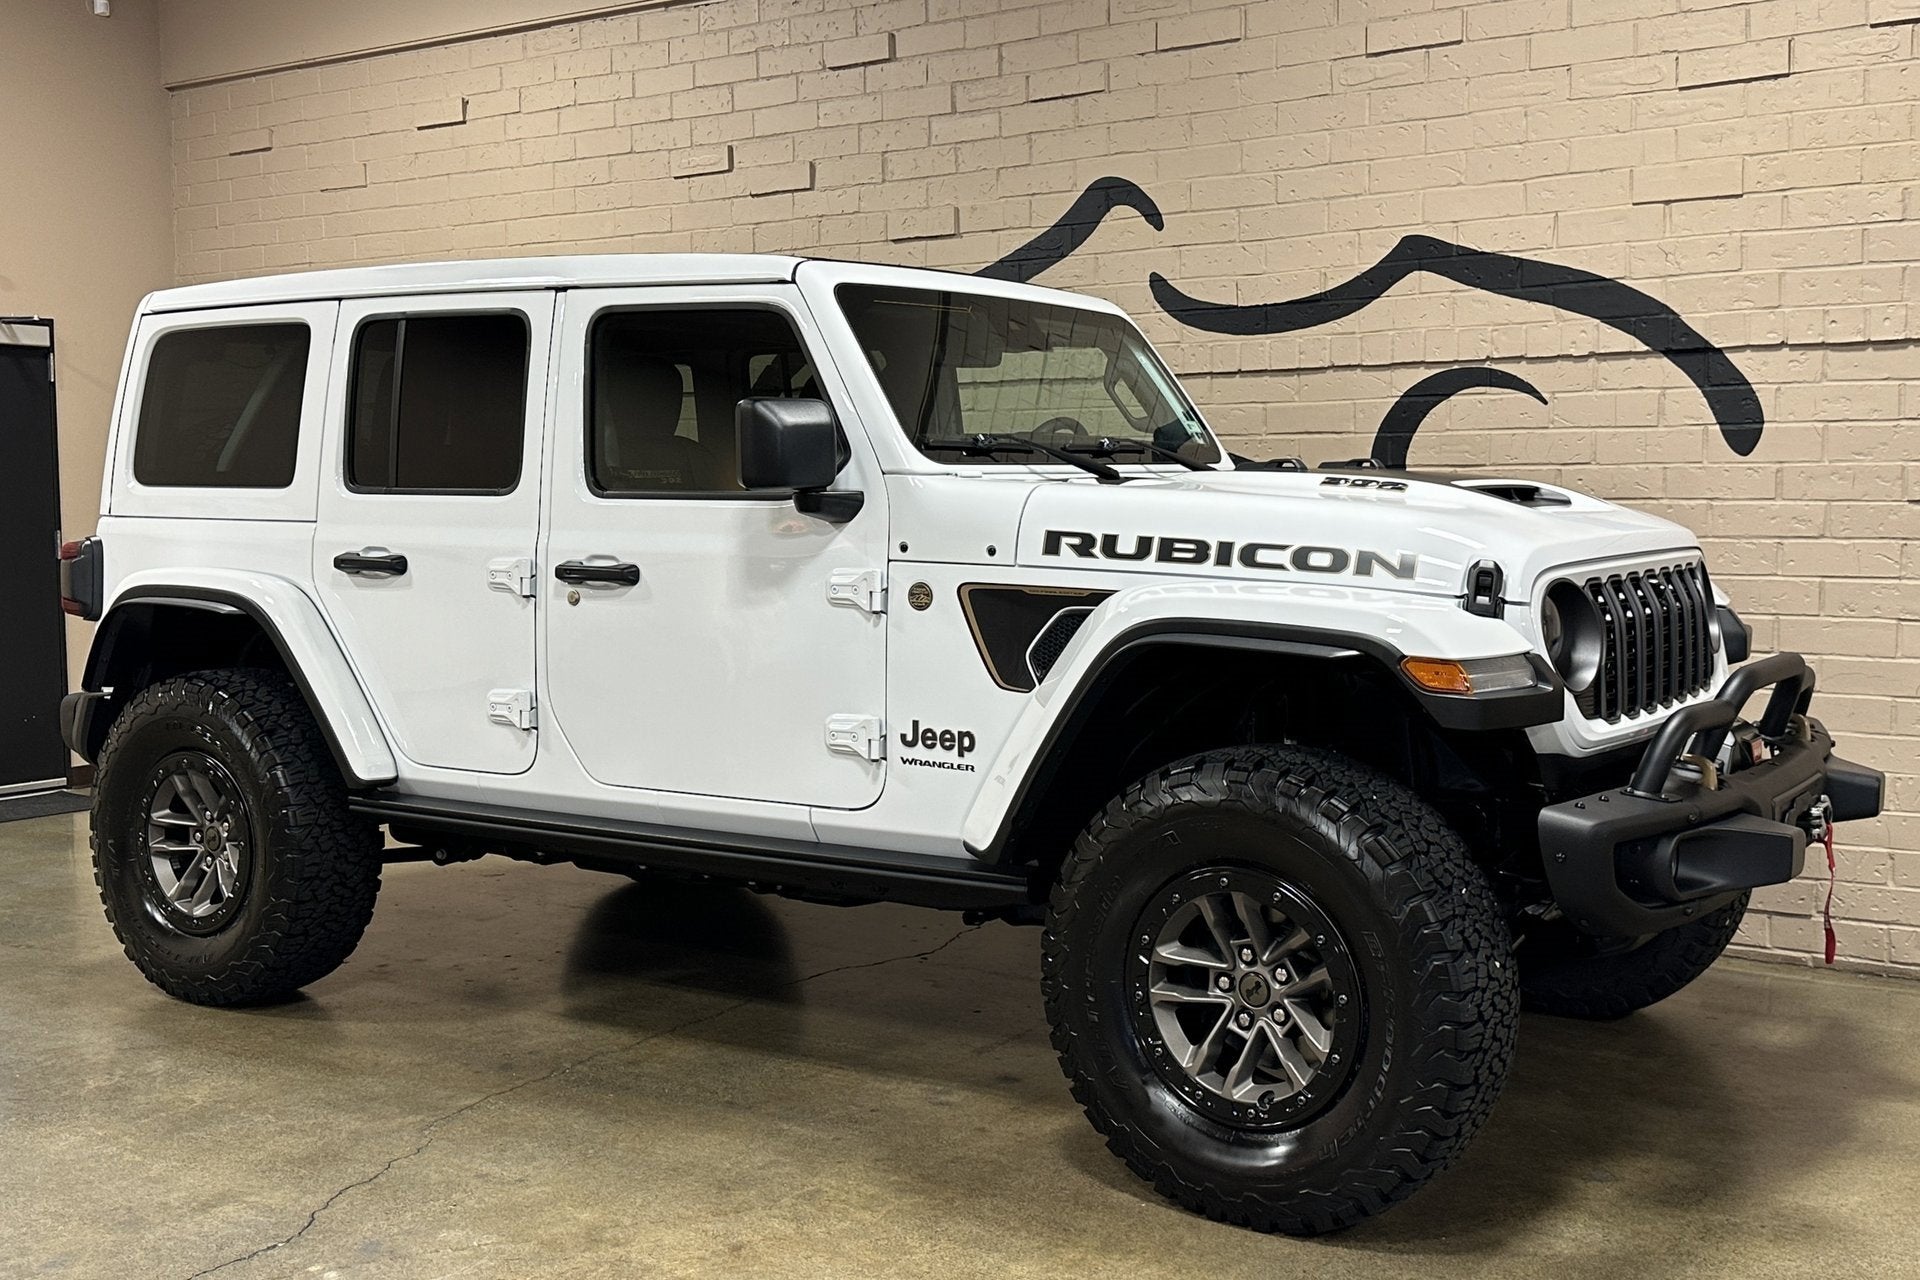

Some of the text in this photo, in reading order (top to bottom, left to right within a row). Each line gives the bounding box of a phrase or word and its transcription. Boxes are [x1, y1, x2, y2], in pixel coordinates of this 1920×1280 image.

[1042, 529, 1419, 579] RUBICON
[900, 719, 976, 758] Jeep
[900, 756, 976, 772] WRANGLER
